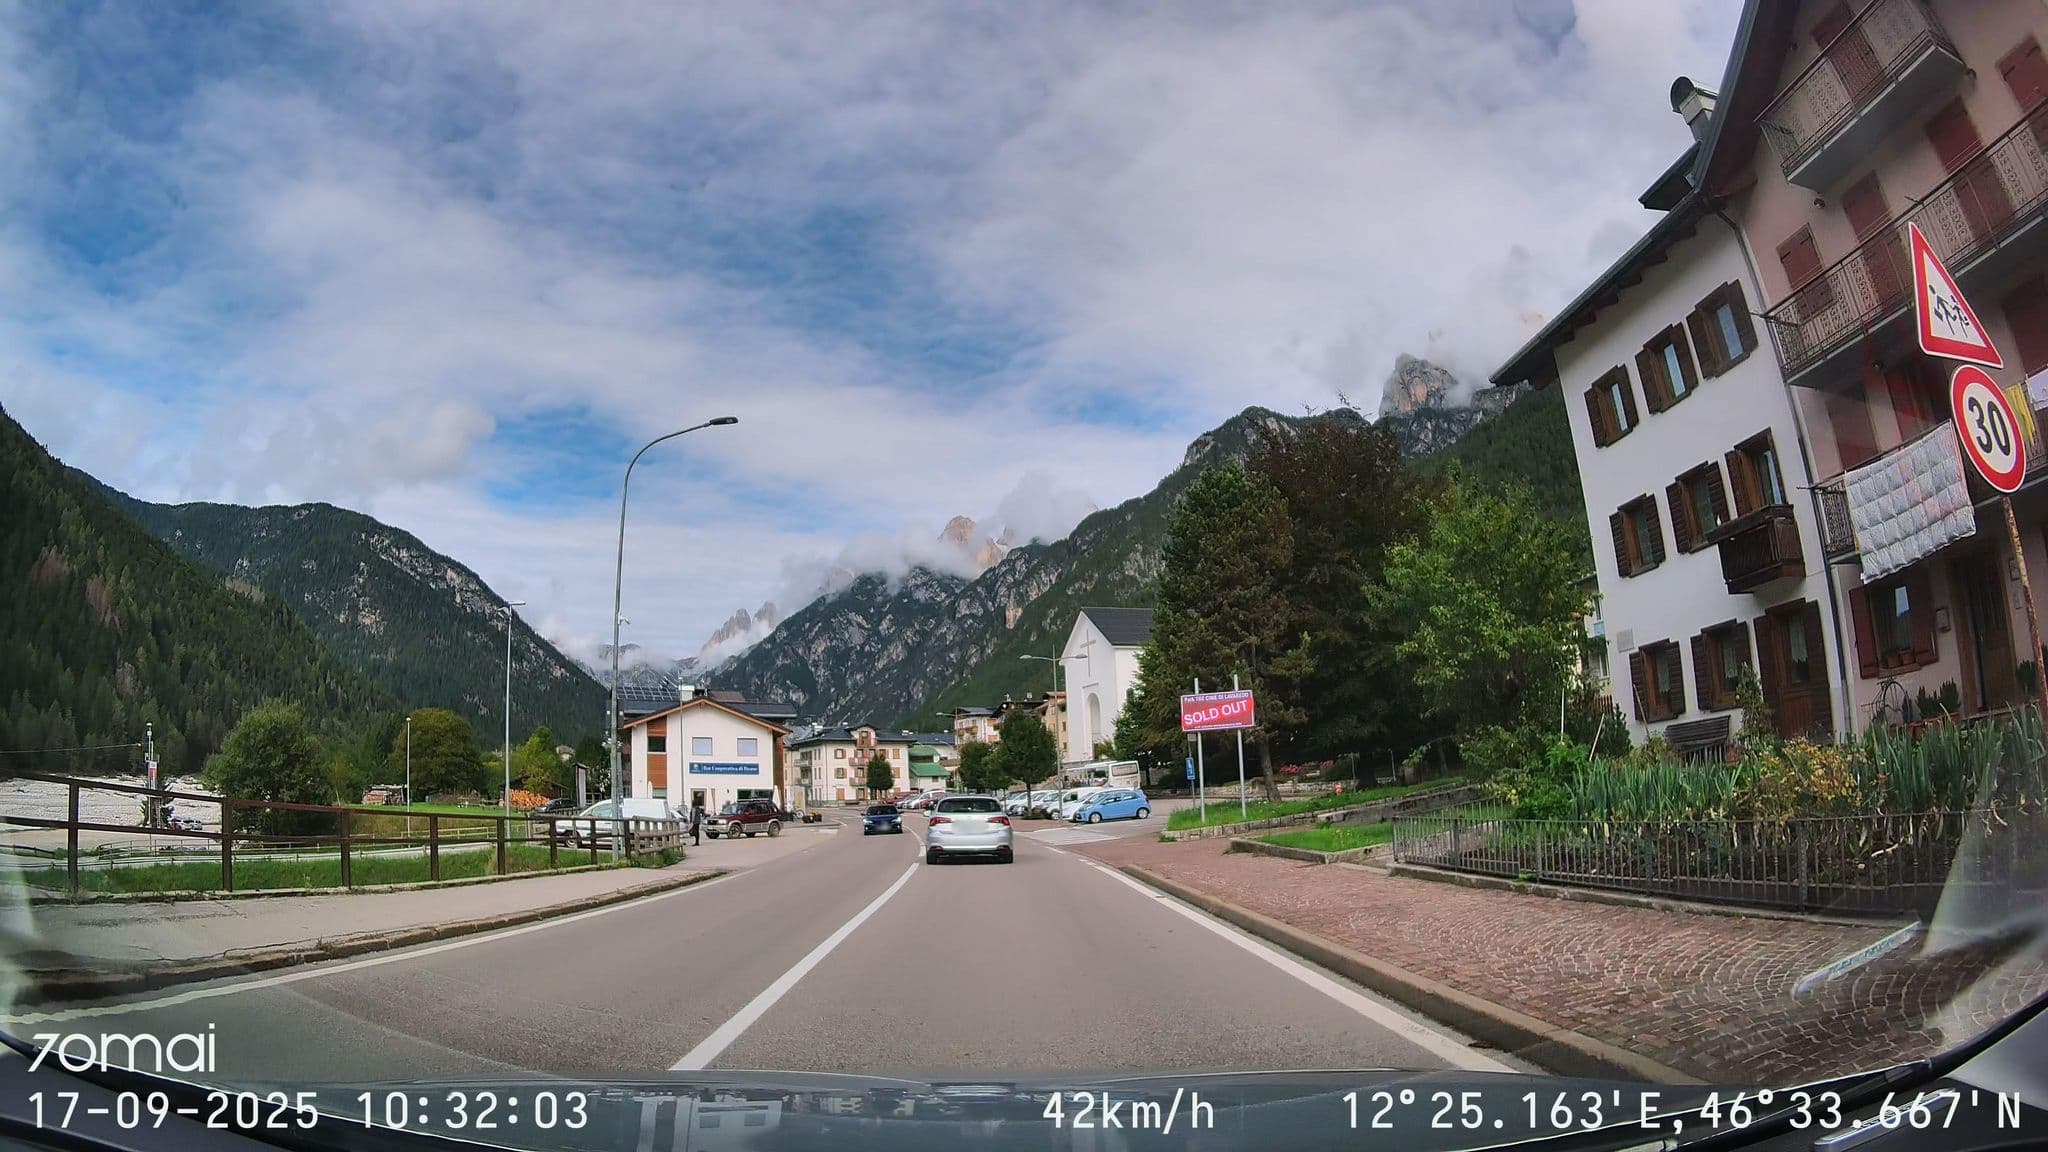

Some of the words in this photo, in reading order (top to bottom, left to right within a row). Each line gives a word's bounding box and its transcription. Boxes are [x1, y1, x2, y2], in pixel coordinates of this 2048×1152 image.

[1968, 396, 2011, 457] 30
[1184, 707, 1219, 725] SOLD
[1221, 700, 1248, 715] OUT
